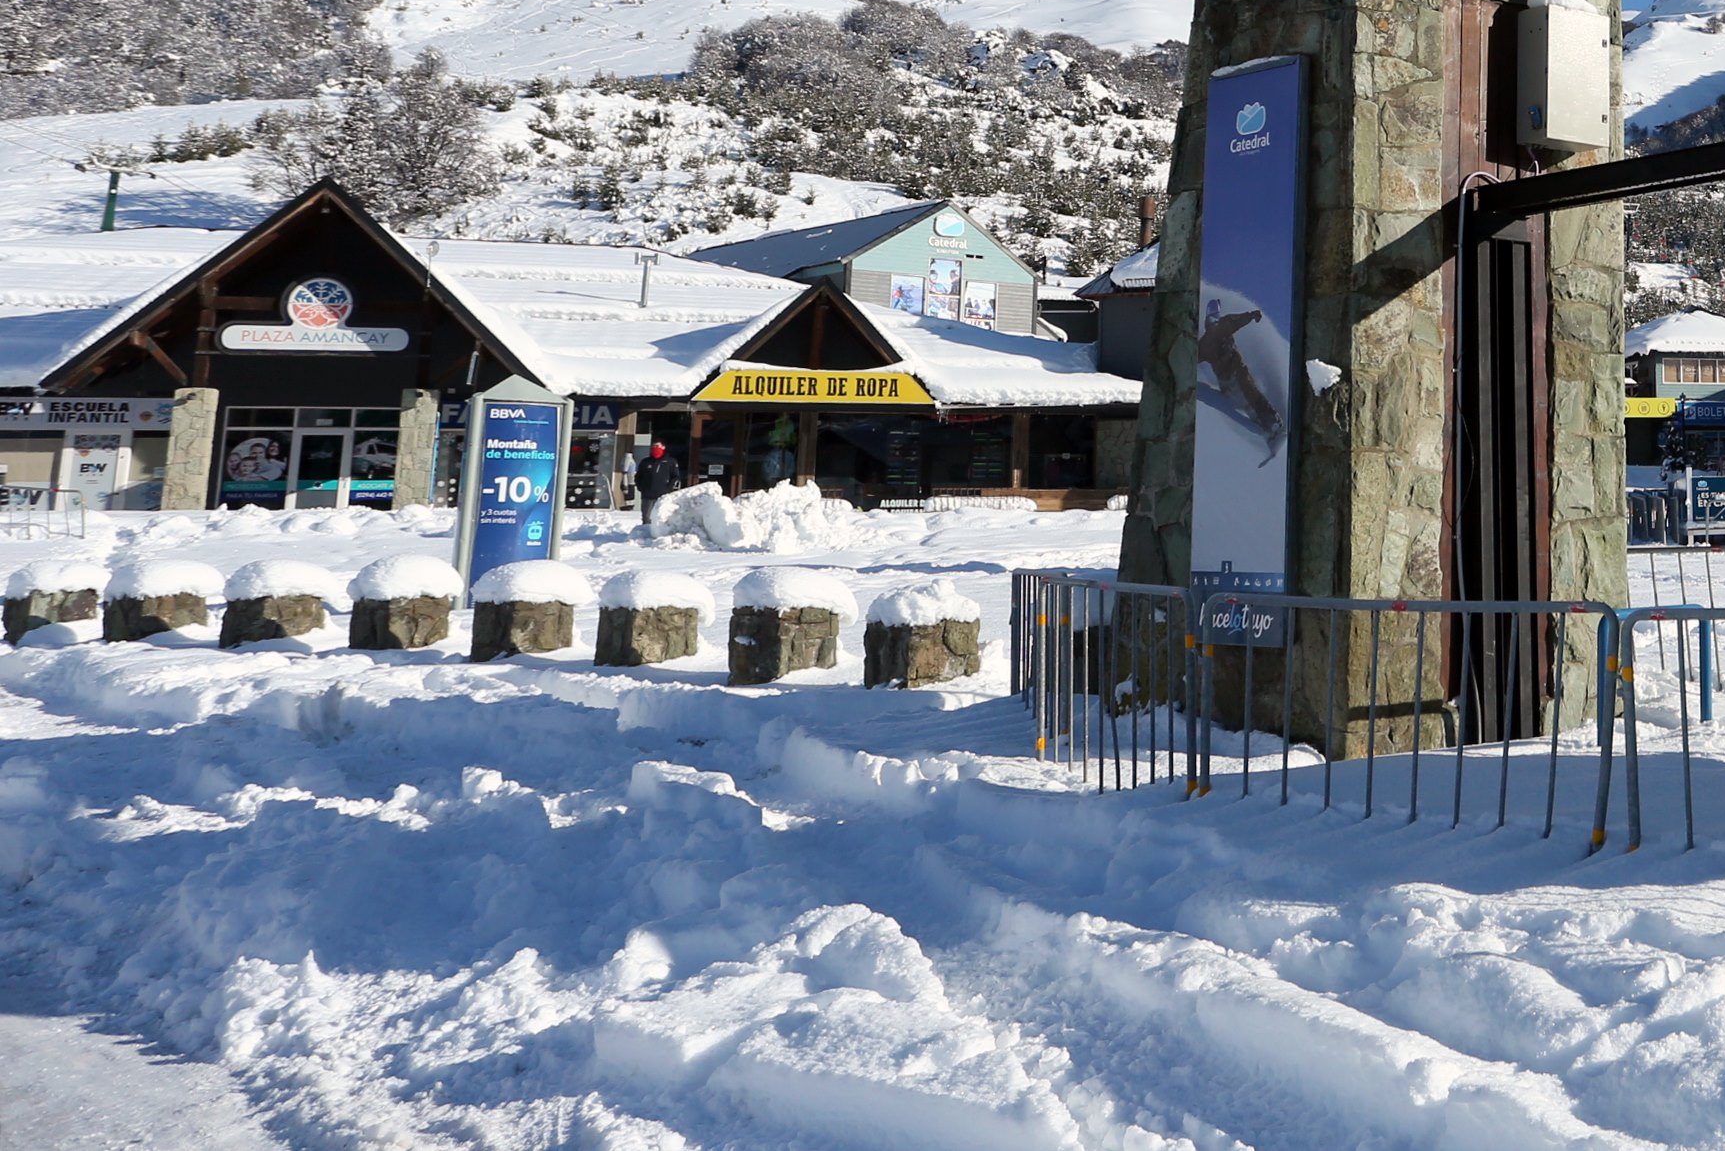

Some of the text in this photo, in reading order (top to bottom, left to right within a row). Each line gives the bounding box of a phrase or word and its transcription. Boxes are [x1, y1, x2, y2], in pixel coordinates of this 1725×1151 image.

[1230, 132, 1270, 153] Catedral
[928, 236, 968, 250] Catedral
[241, 330, 389, 344] PLAZA AMANCAY
[732, 376, 899, 397] ALQUILER DE ROPA
[50, 402, 129, 412] ESCUELA
[48, 412, 129, 423] INFANTIL
[490, 409, 526, 419] BBVA
[487, 440, 537, 449] Montaña
[486, 450, 555, 460] de beneficios
[880, 499, 918, 508] ALQUILER
